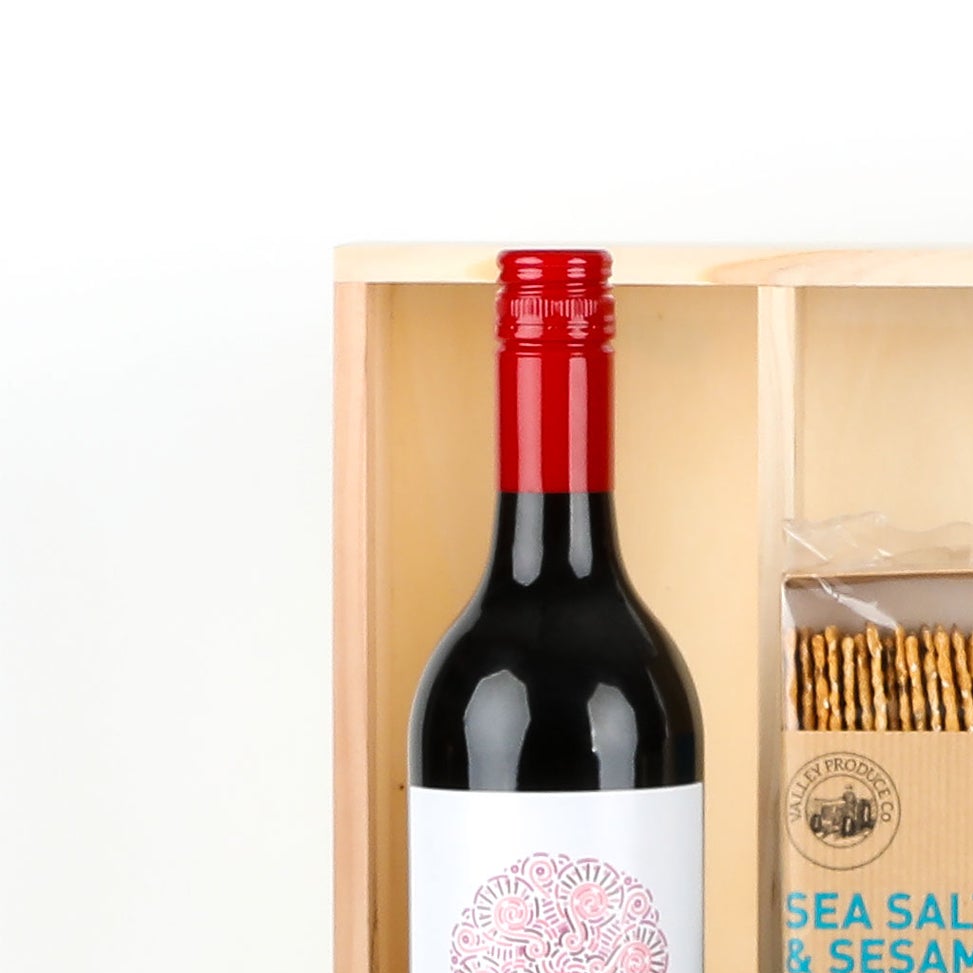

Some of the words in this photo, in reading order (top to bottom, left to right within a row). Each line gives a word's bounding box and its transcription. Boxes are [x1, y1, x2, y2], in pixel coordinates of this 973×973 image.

[789, 763, 822, 822] VALLEY
[825, 758, 891, 798] PRODUCE
[786, 892, 872, 931] SEA
